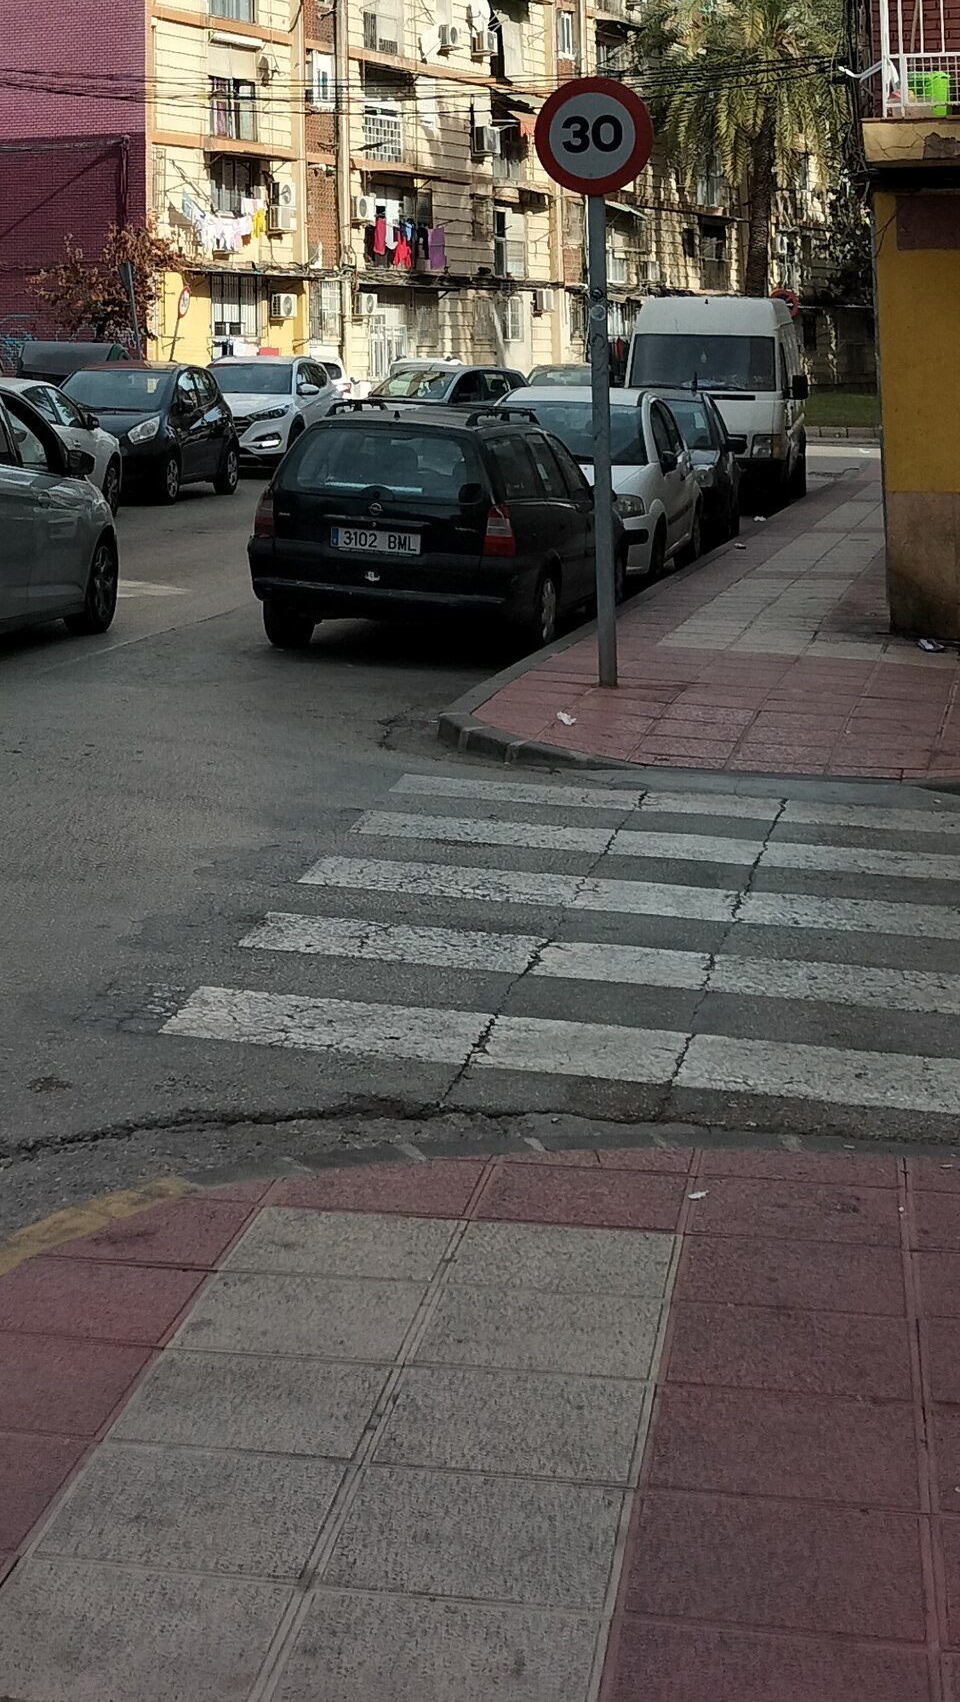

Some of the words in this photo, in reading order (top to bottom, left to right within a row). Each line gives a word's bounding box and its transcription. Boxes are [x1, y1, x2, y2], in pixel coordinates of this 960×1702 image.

[562, 114, 623, 154] 30
[343, 530, 378, 548] 3102
[387, 534, 417, 552] BML
